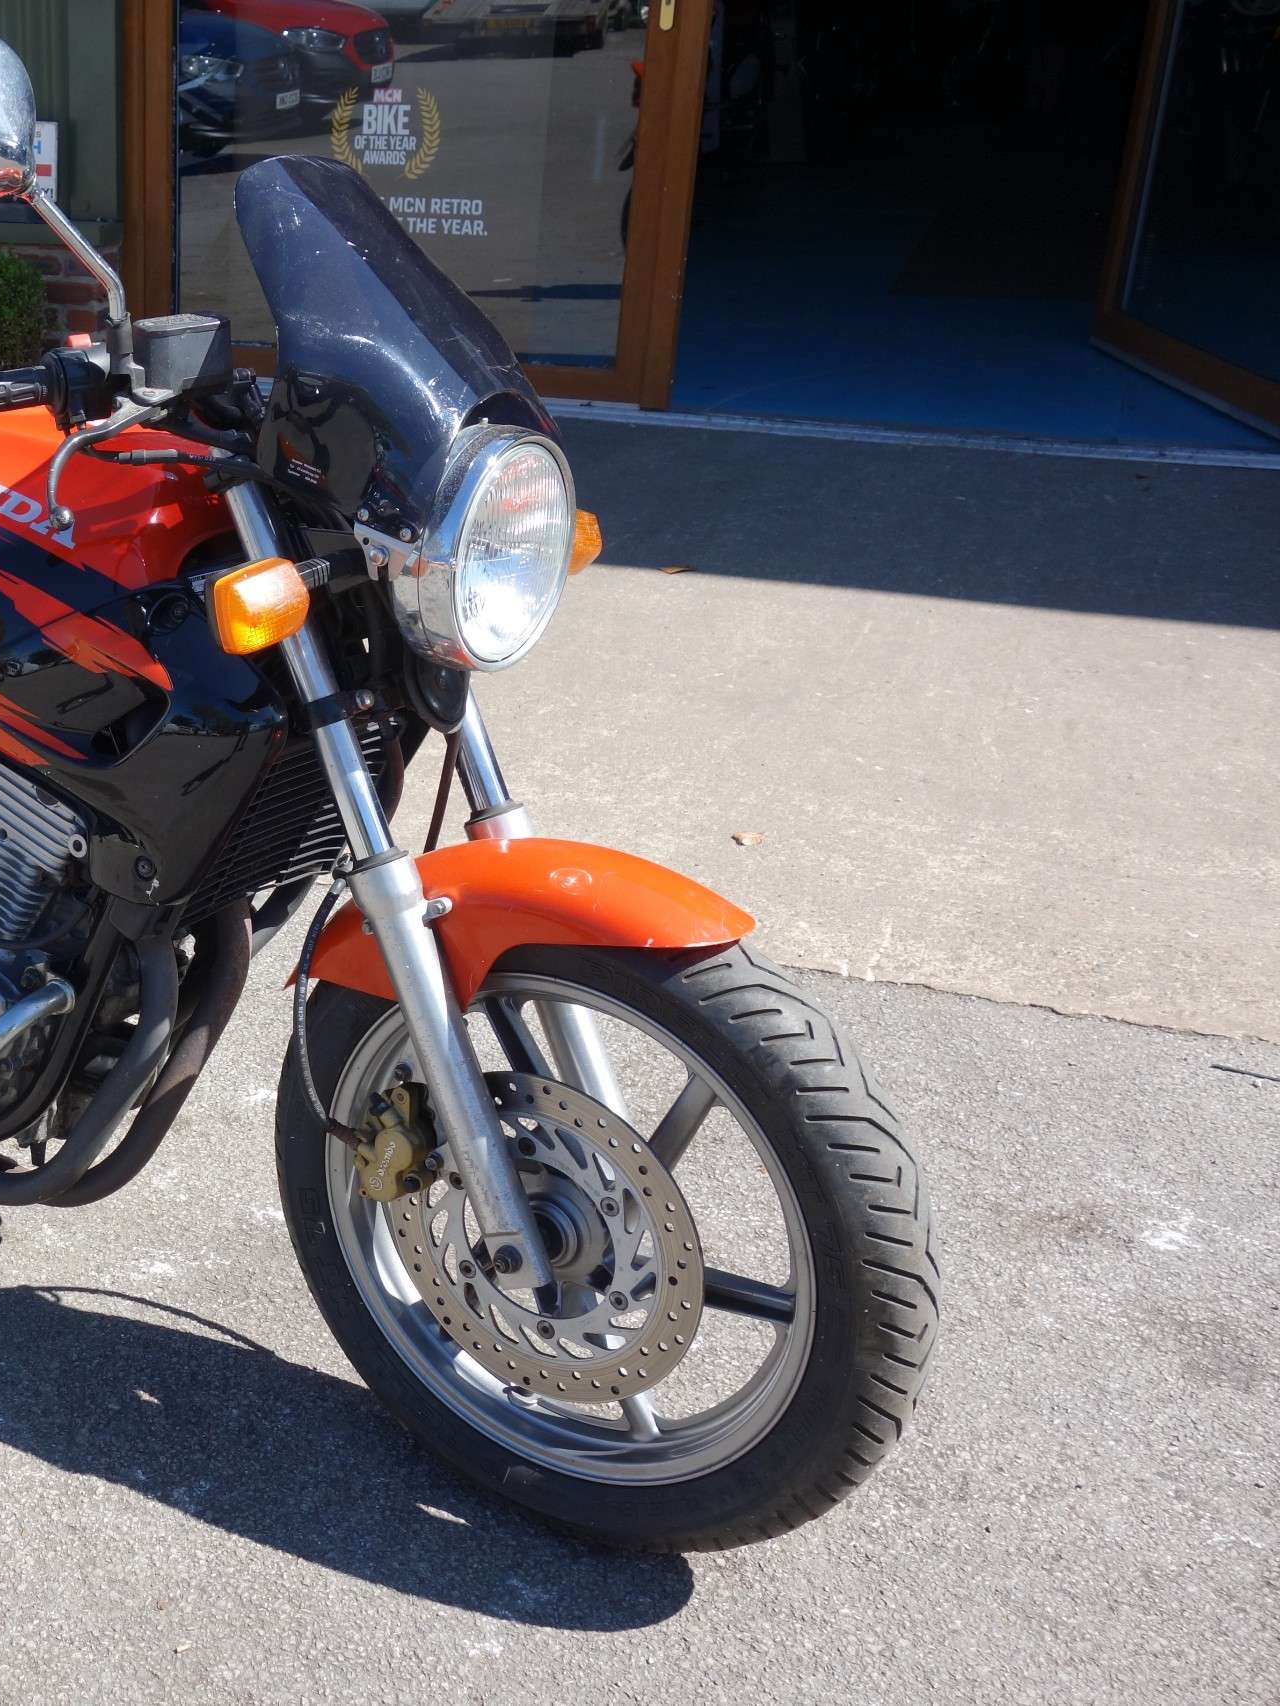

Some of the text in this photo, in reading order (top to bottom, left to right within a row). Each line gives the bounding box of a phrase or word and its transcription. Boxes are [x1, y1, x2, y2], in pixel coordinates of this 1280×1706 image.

[373, 89, 402, 103] MCN
[362, 104, 411, 135] BIKE
[354, 135, 417, 150] OF THE YEAR
[363, 150, 406, 165] AWARDS
[388, 197, 483, 216] MCN RETRO
[407, 217, 488, 236] THE YEAR.
